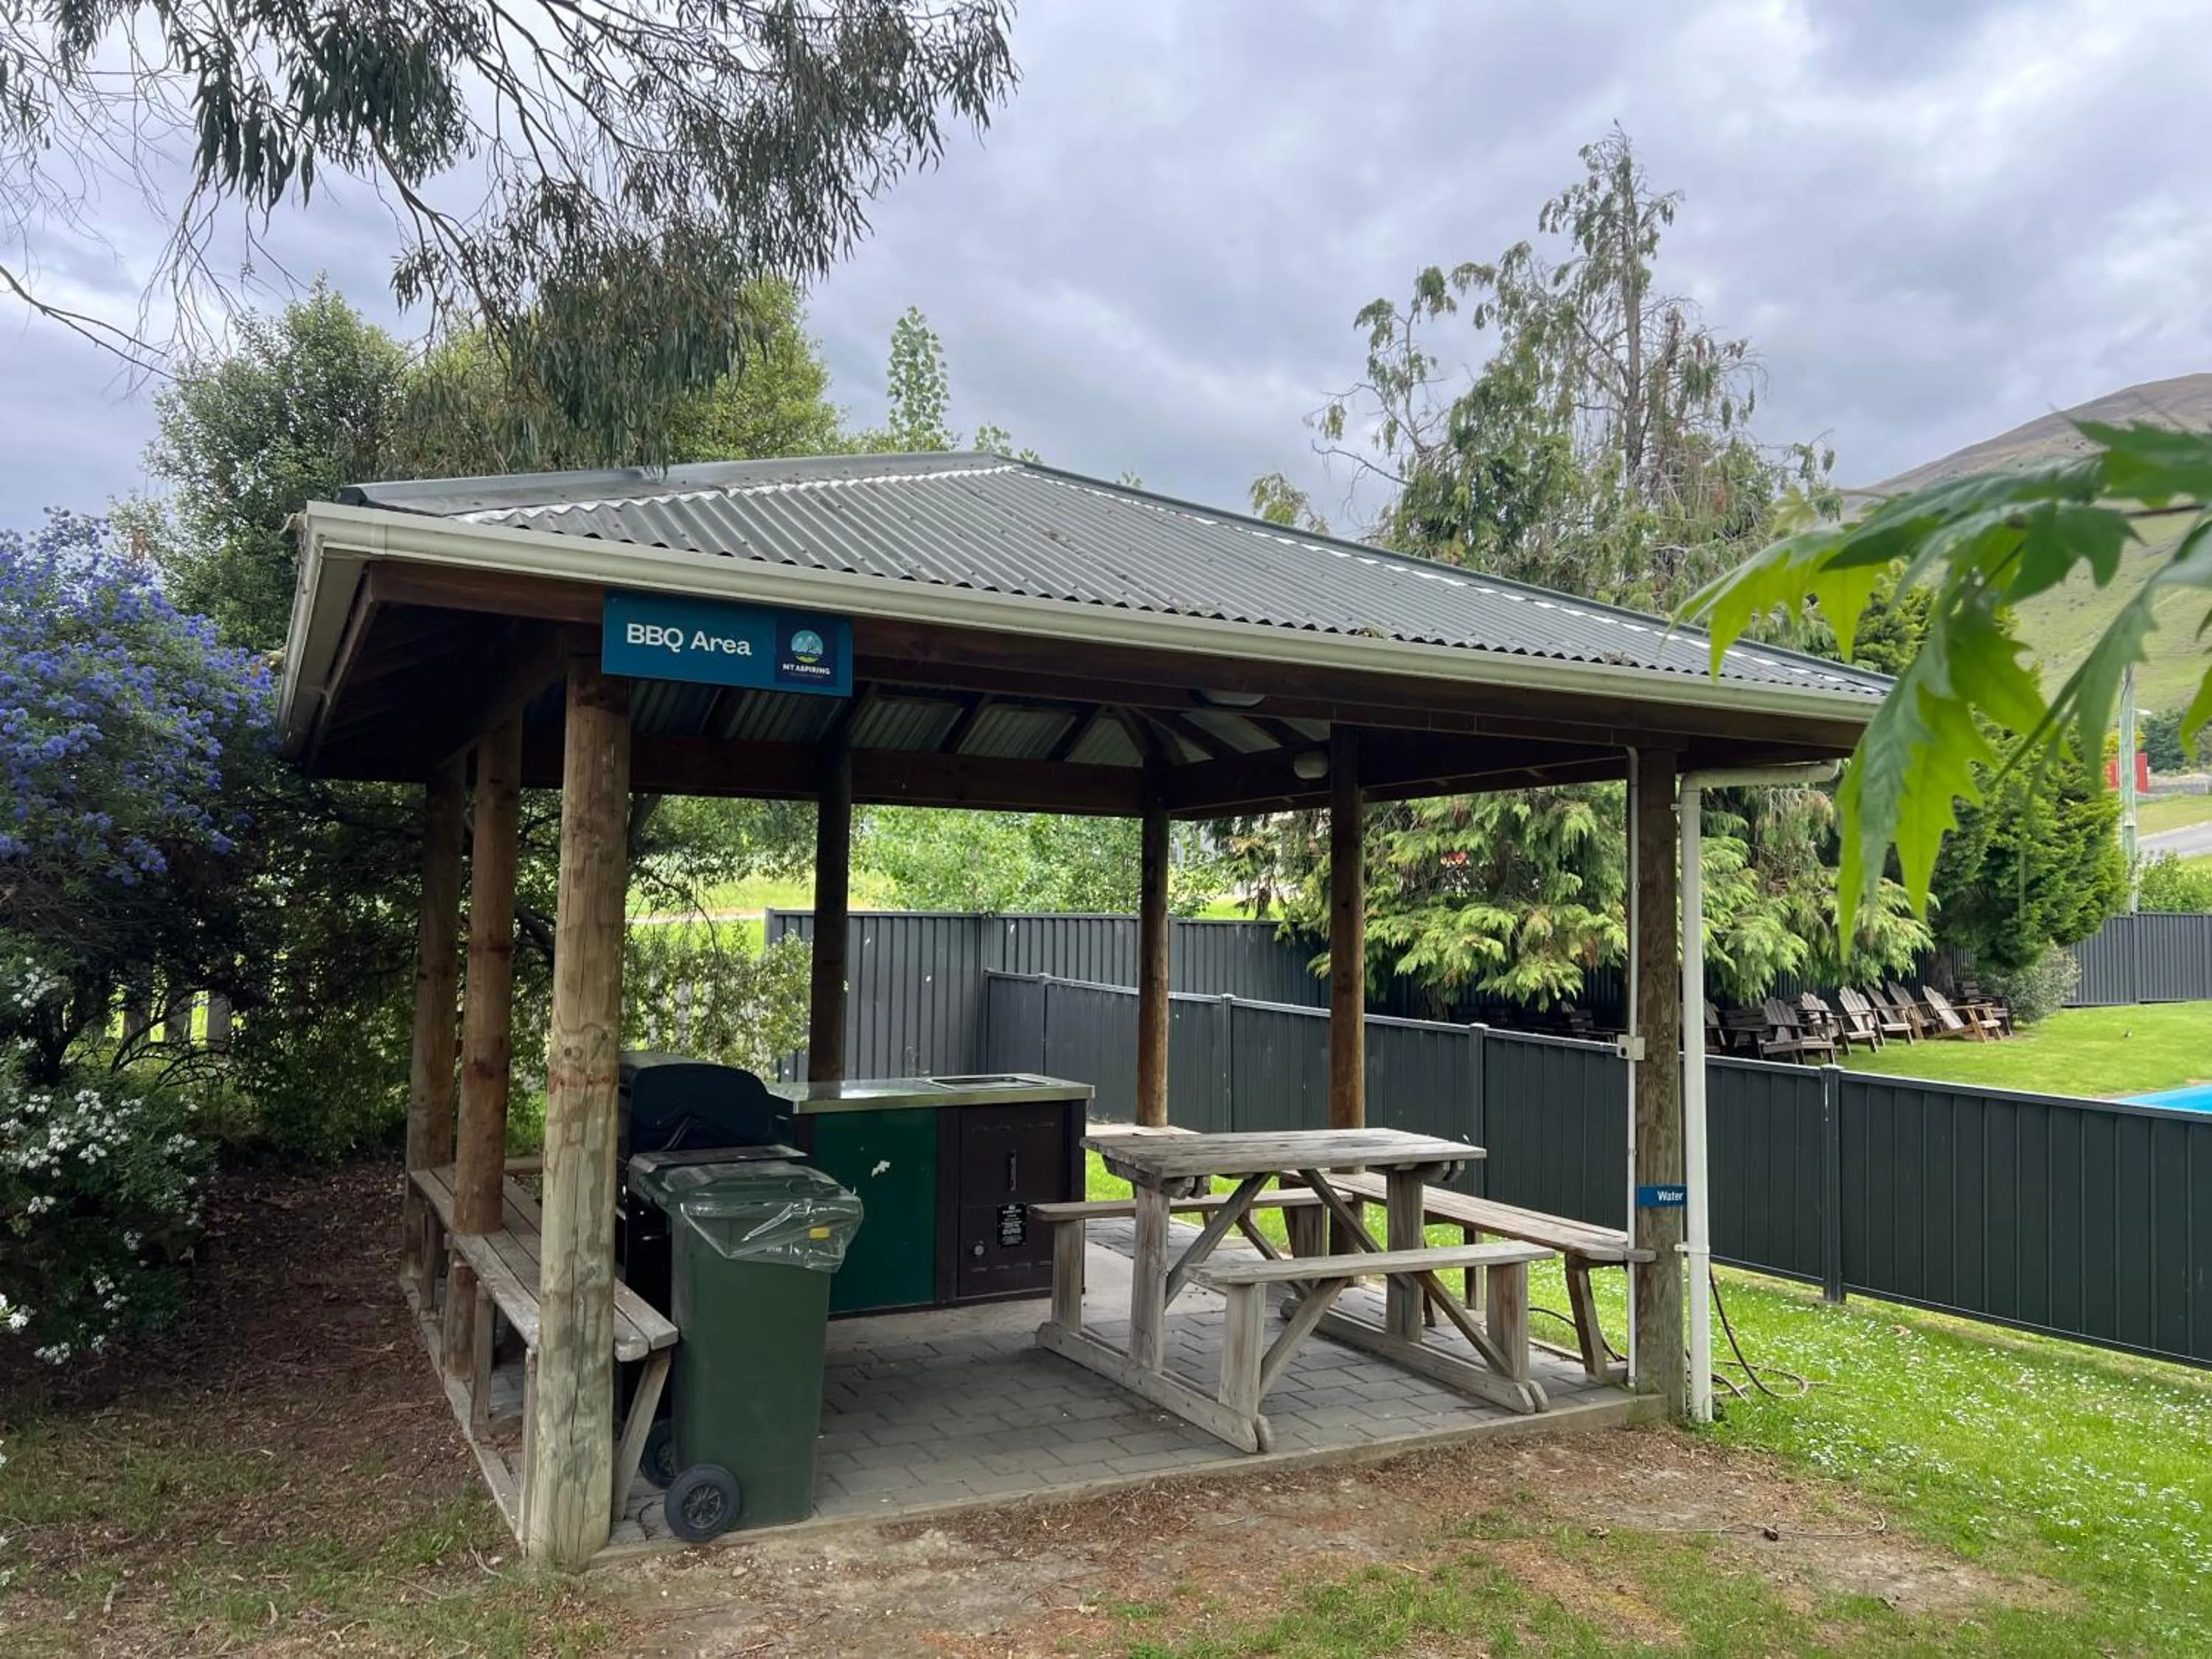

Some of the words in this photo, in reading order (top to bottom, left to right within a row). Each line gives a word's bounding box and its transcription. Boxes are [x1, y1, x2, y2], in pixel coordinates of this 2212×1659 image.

[627, 623, 684, 653] BBQ
[689, 630, 753, 656] Area
[796, 664, 830, 675] ASPIRING
[1657, 1191, 1684, 1201] Water
